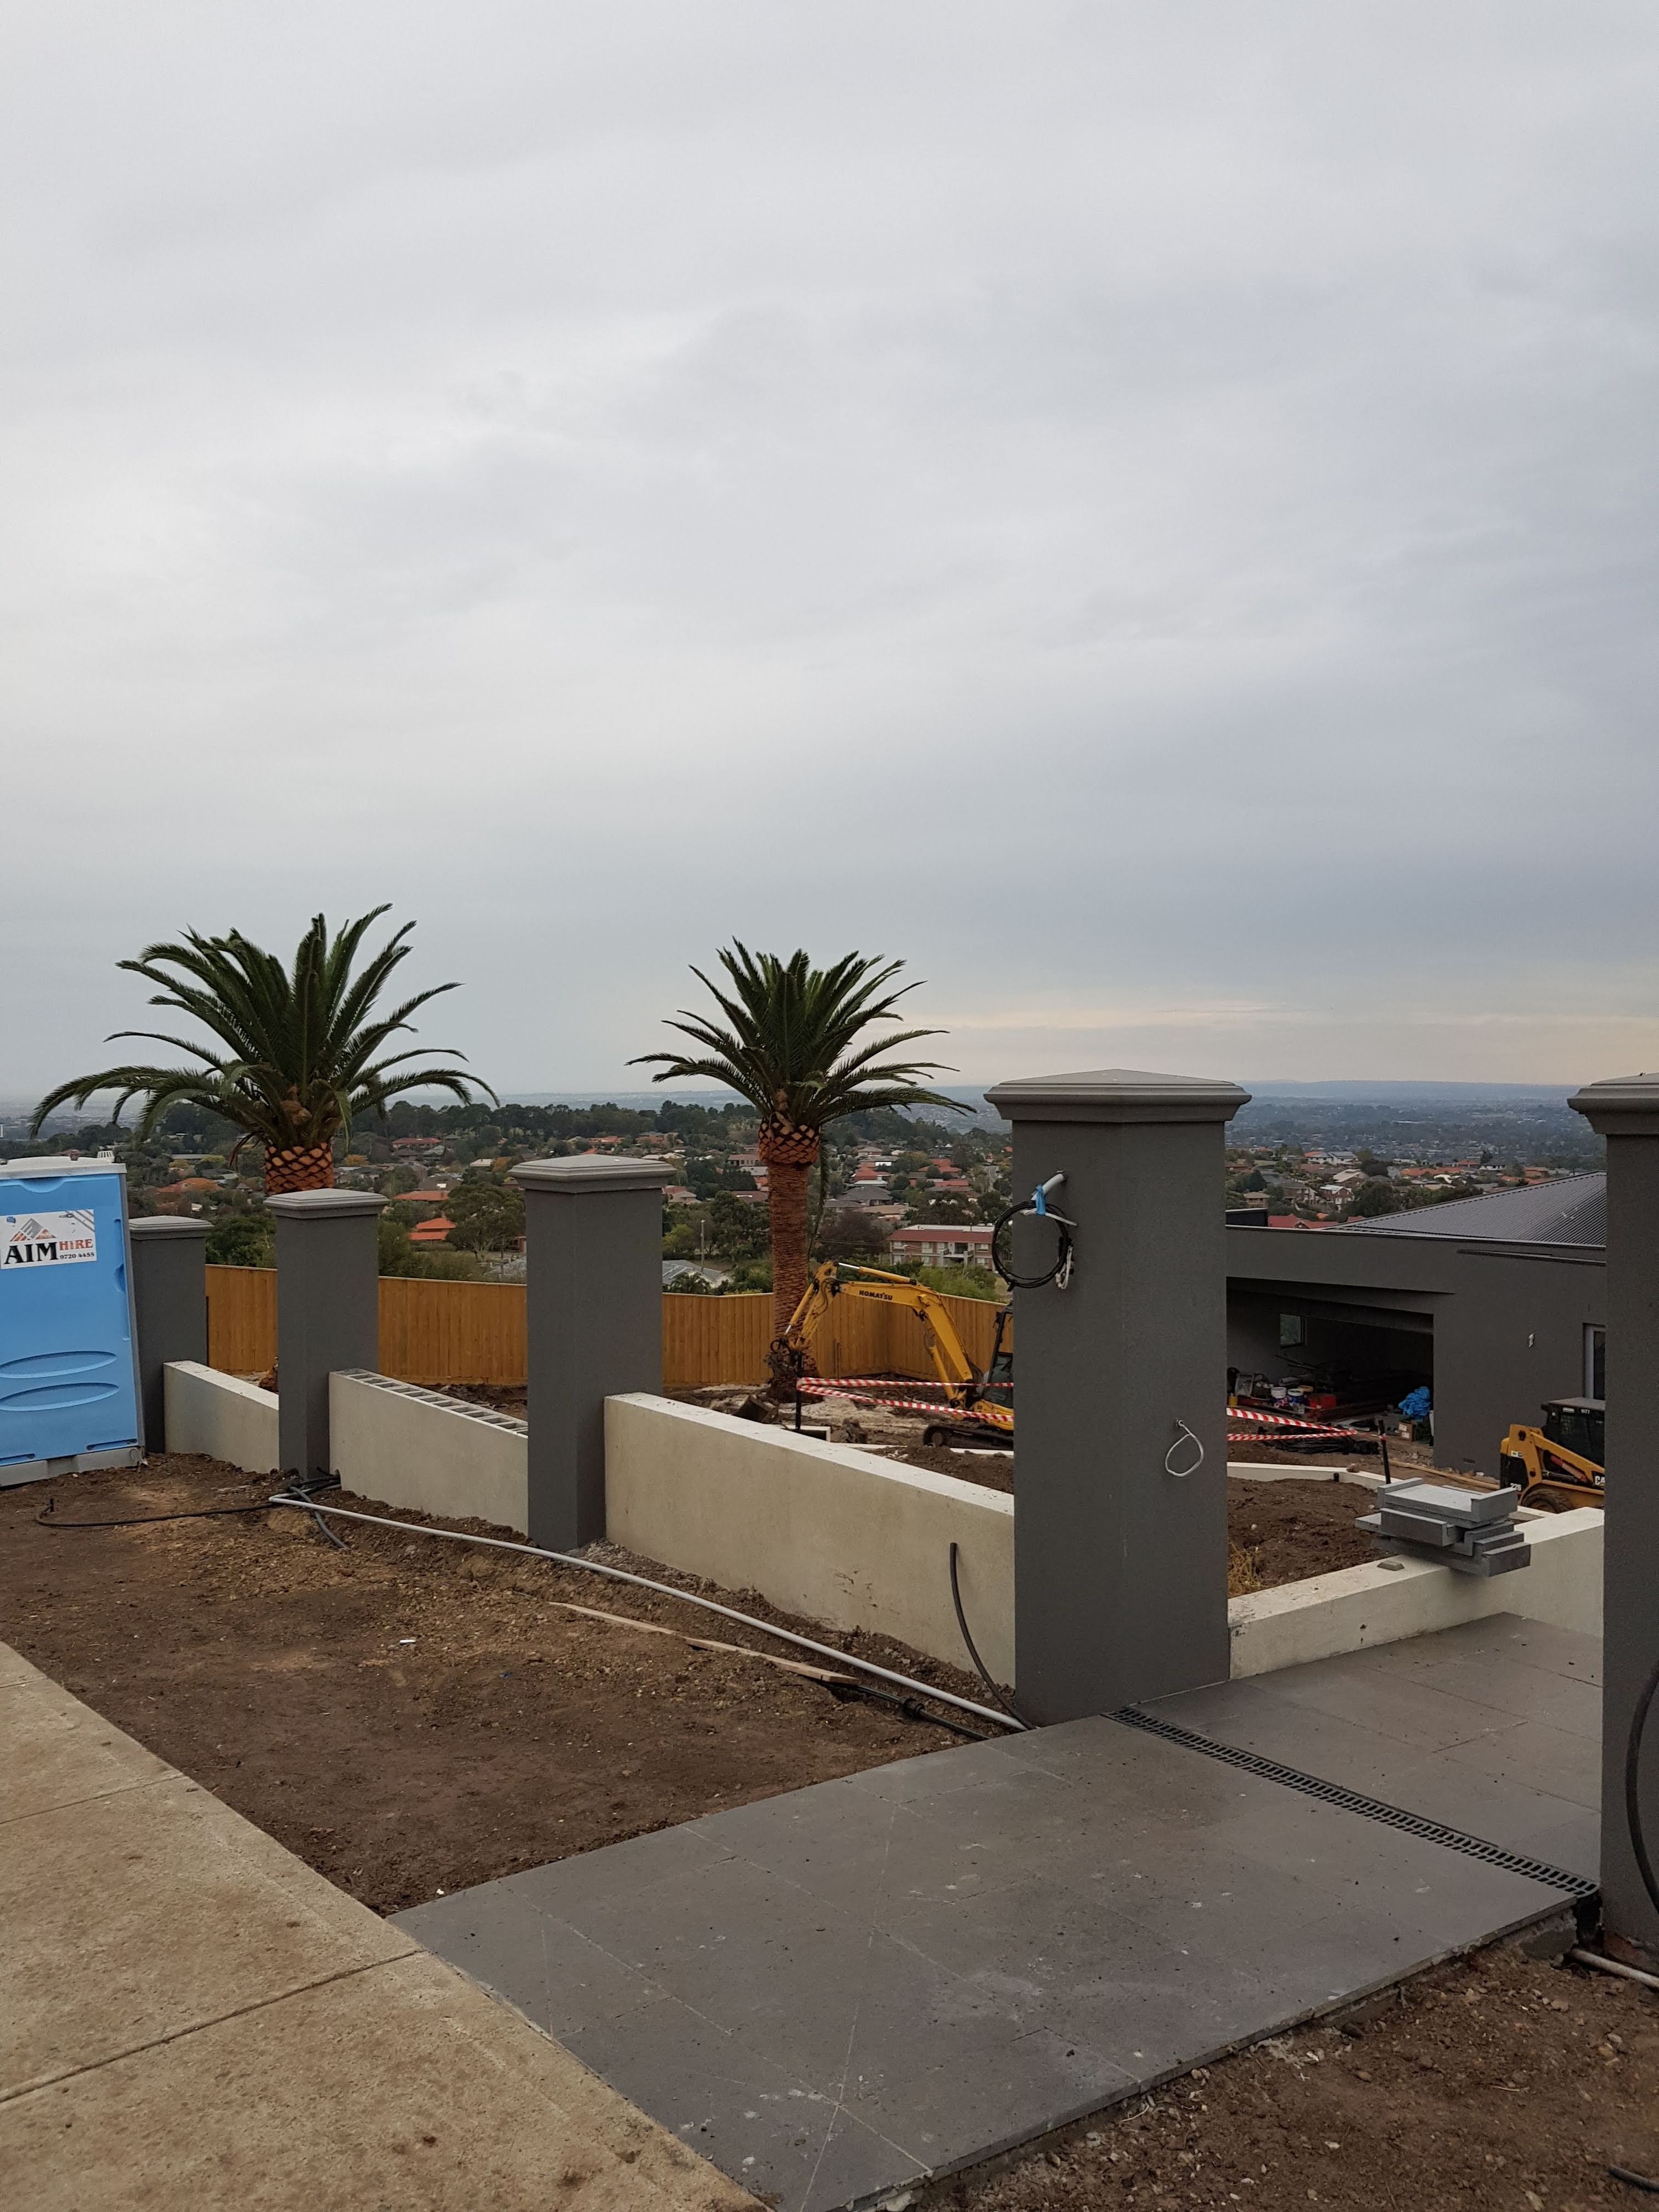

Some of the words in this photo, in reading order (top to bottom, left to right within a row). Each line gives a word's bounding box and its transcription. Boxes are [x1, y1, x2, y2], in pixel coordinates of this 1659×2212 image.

[3, 1242, 59, 1265] AIM
[59, 1239, 93, 1250] HIRE
[859, 1290, 893, 1300] KOMATSU
[1595, 1475, 1605, 1485] CA
